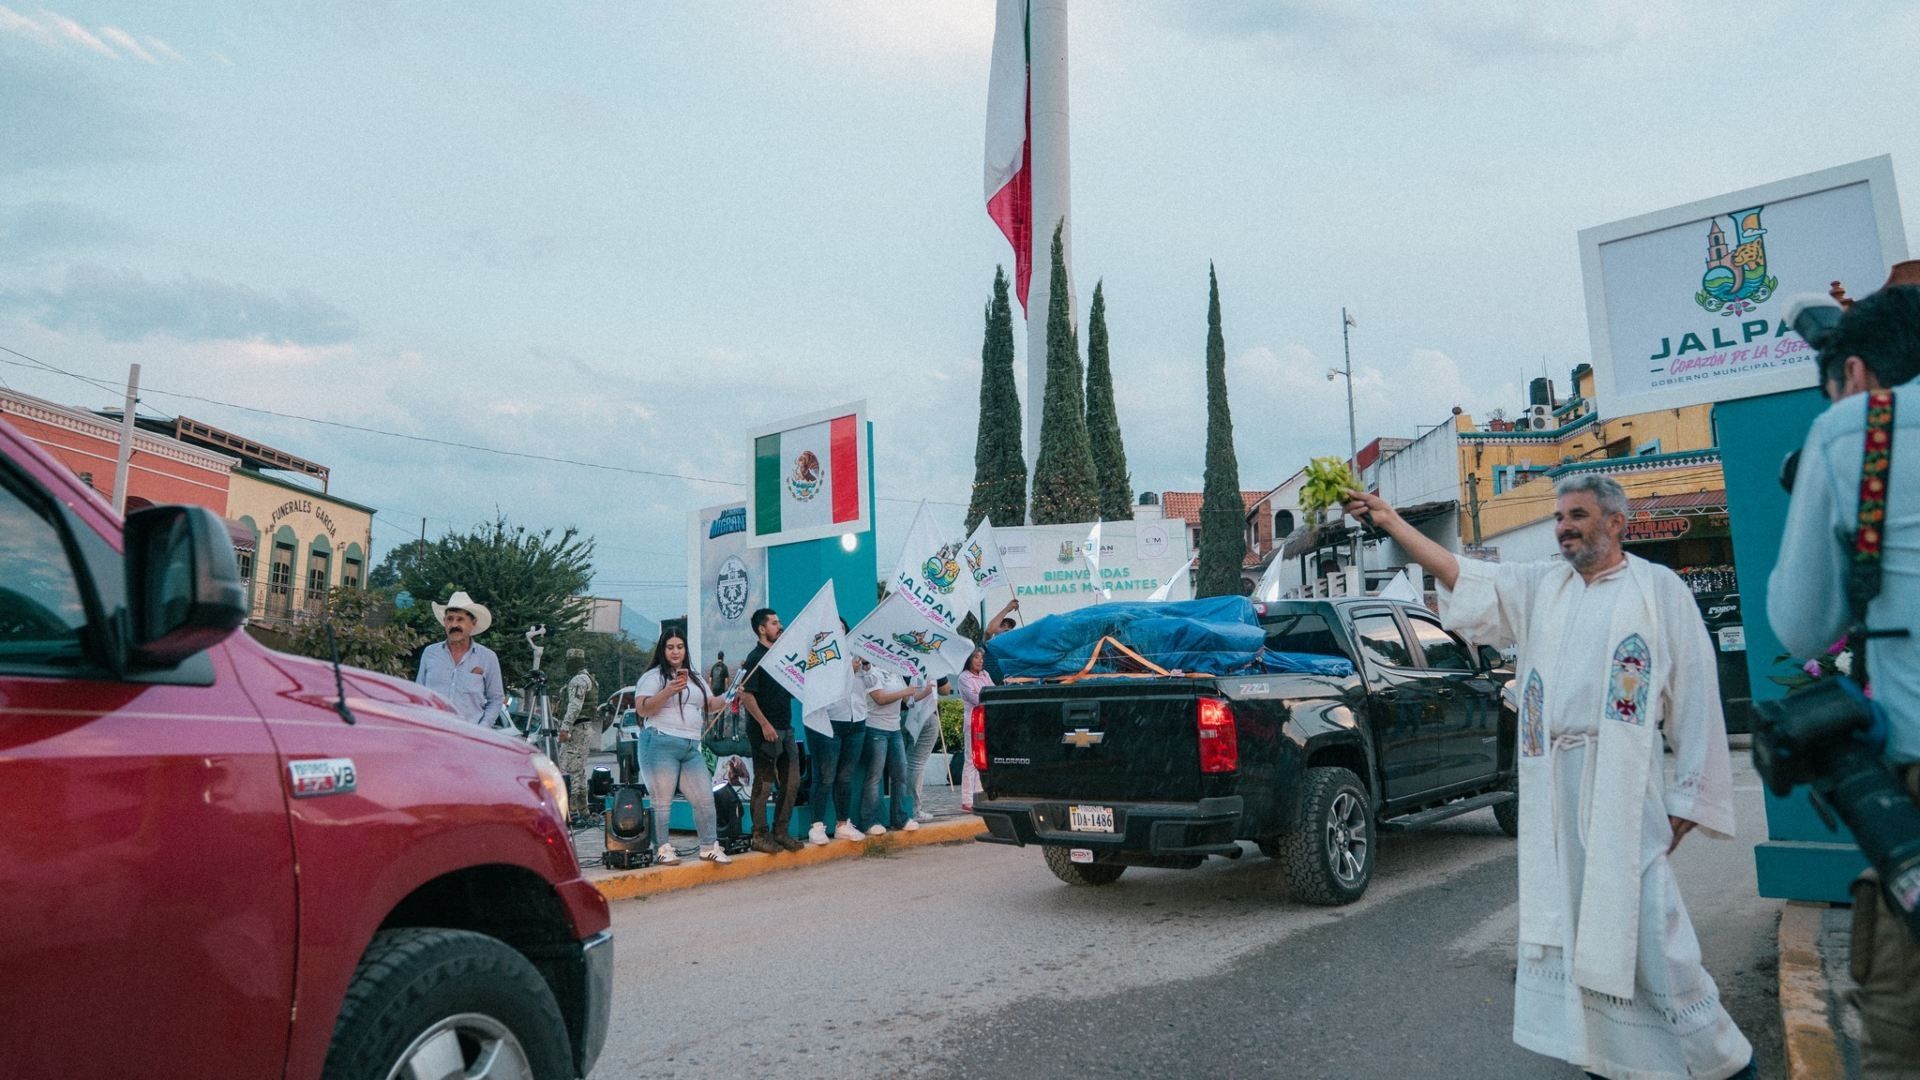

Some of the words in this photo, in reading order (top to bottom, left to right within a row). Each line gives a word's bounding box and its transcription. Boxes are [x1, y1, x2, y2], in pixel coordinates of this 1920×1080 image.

[1650, 319, 1797, 360] JALPA
[1651, 372, 1709, 387] GOBIERNO
[1712, 361, 1776, 377] MUNICIPAL
[272, 500, 312, 524] FUNERALES
[315, 506, 337, 539] GARCIA
[1016, 583, 1077, 596] FAMILIAS
[1043, 567, 1130, 582] BIENVEIDAS
[899, 571, 957, 625] JALPAN
